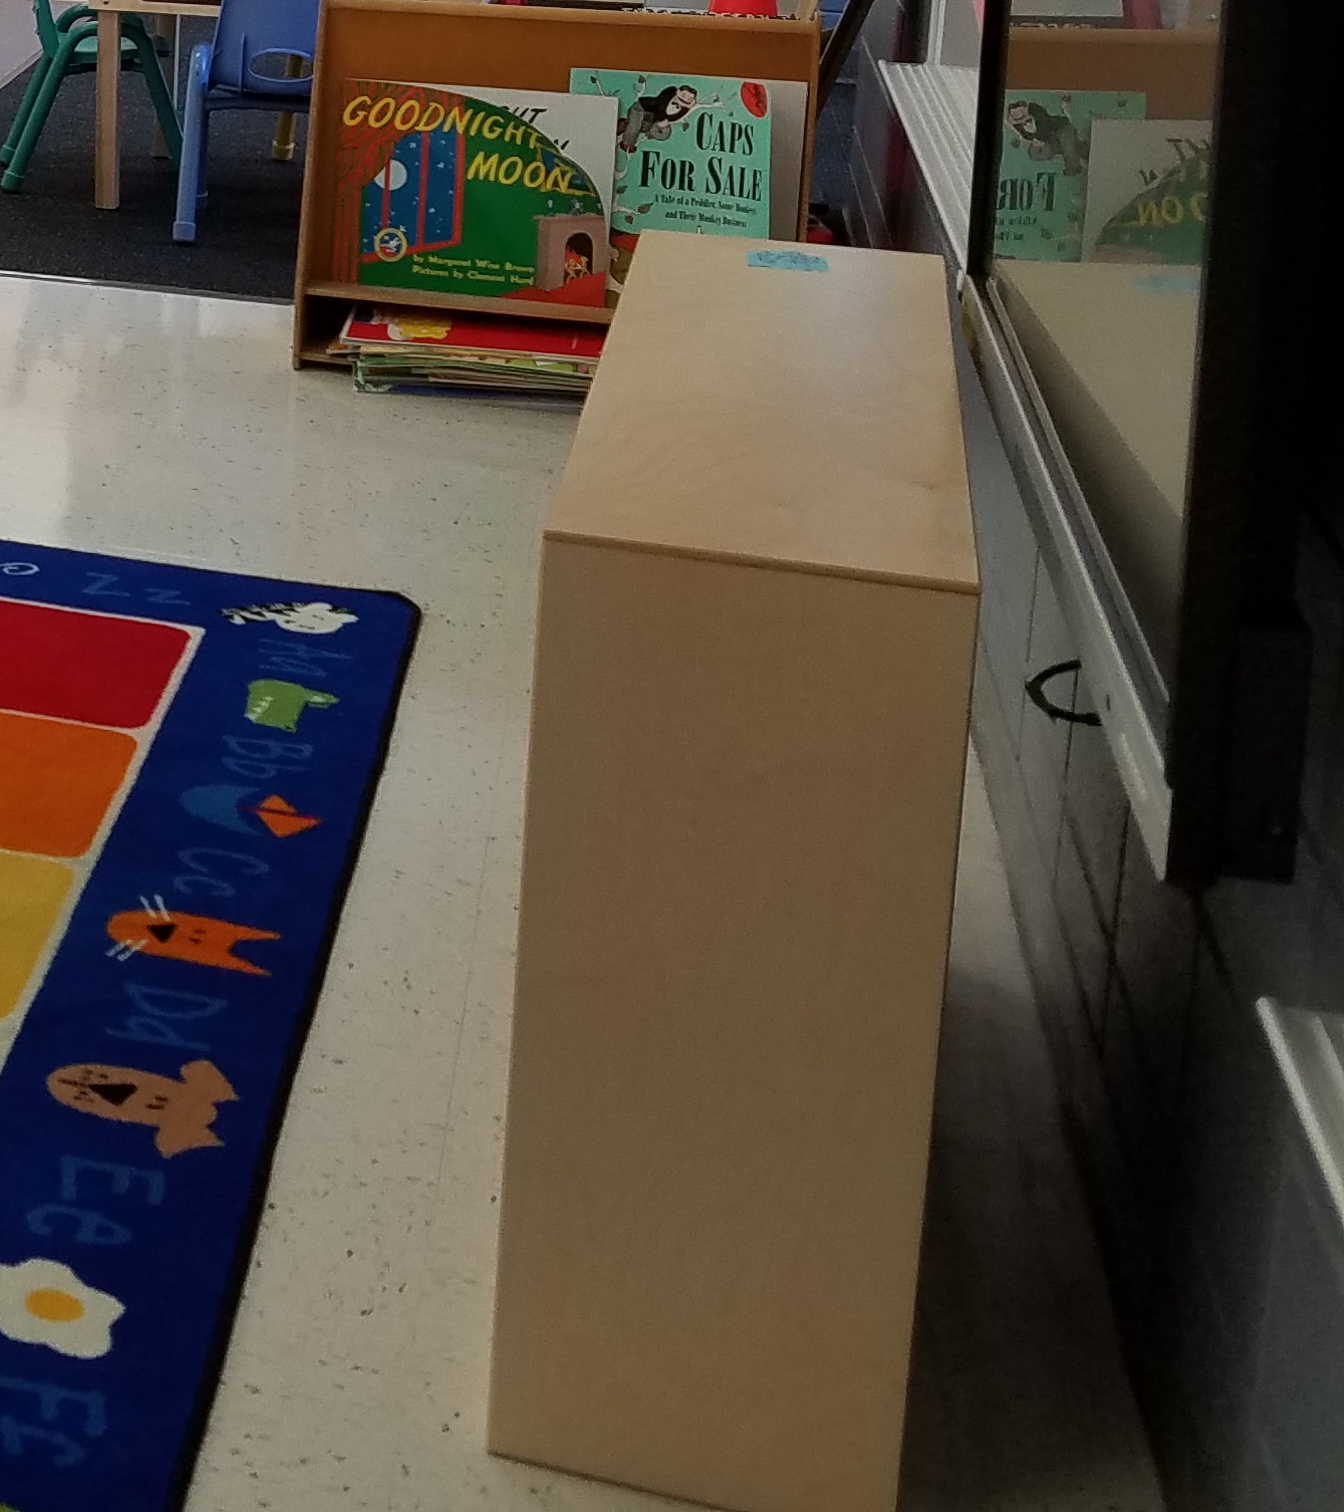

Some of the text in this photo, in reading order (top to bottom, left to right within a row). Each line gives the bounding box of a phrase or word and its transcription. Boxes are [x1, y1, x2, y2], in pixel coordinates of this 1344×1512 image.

[342, 95, 542, 150] GOODNIGHT
[696, 111, 754, 156] CAPS
[467, 152, 575, 192] MOON
[638, 150, 763, 202] FOR SALE
